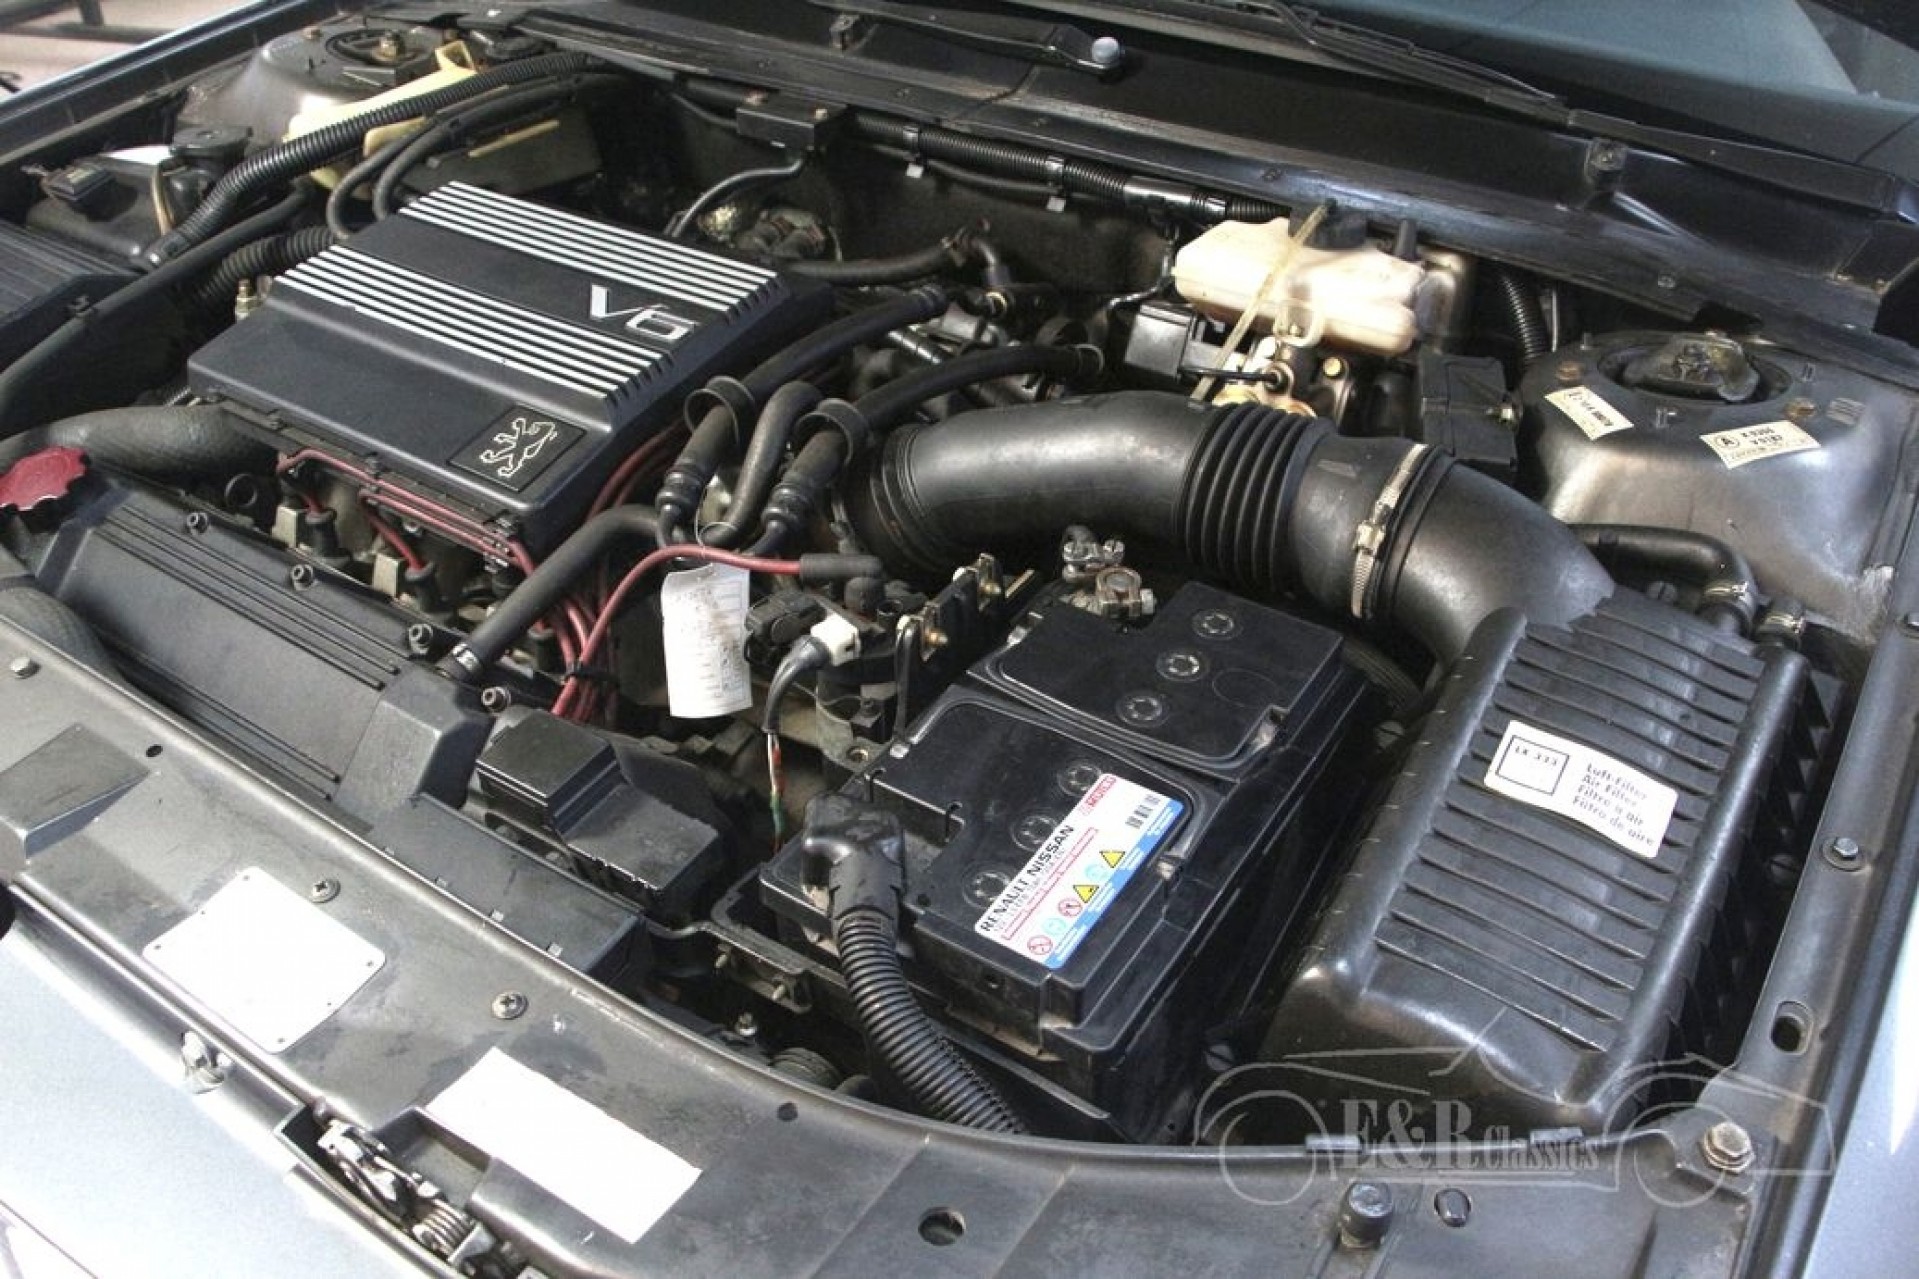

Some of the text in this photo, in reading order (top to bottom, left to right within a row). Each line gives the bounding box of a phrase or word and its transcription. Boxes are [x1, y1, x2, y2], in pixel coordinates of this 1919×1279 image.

[590, 284, 699, 341] V6
[980, 879, 1029, 932] RENAULT
[1026, 824, 1076, 879] NISSAN
